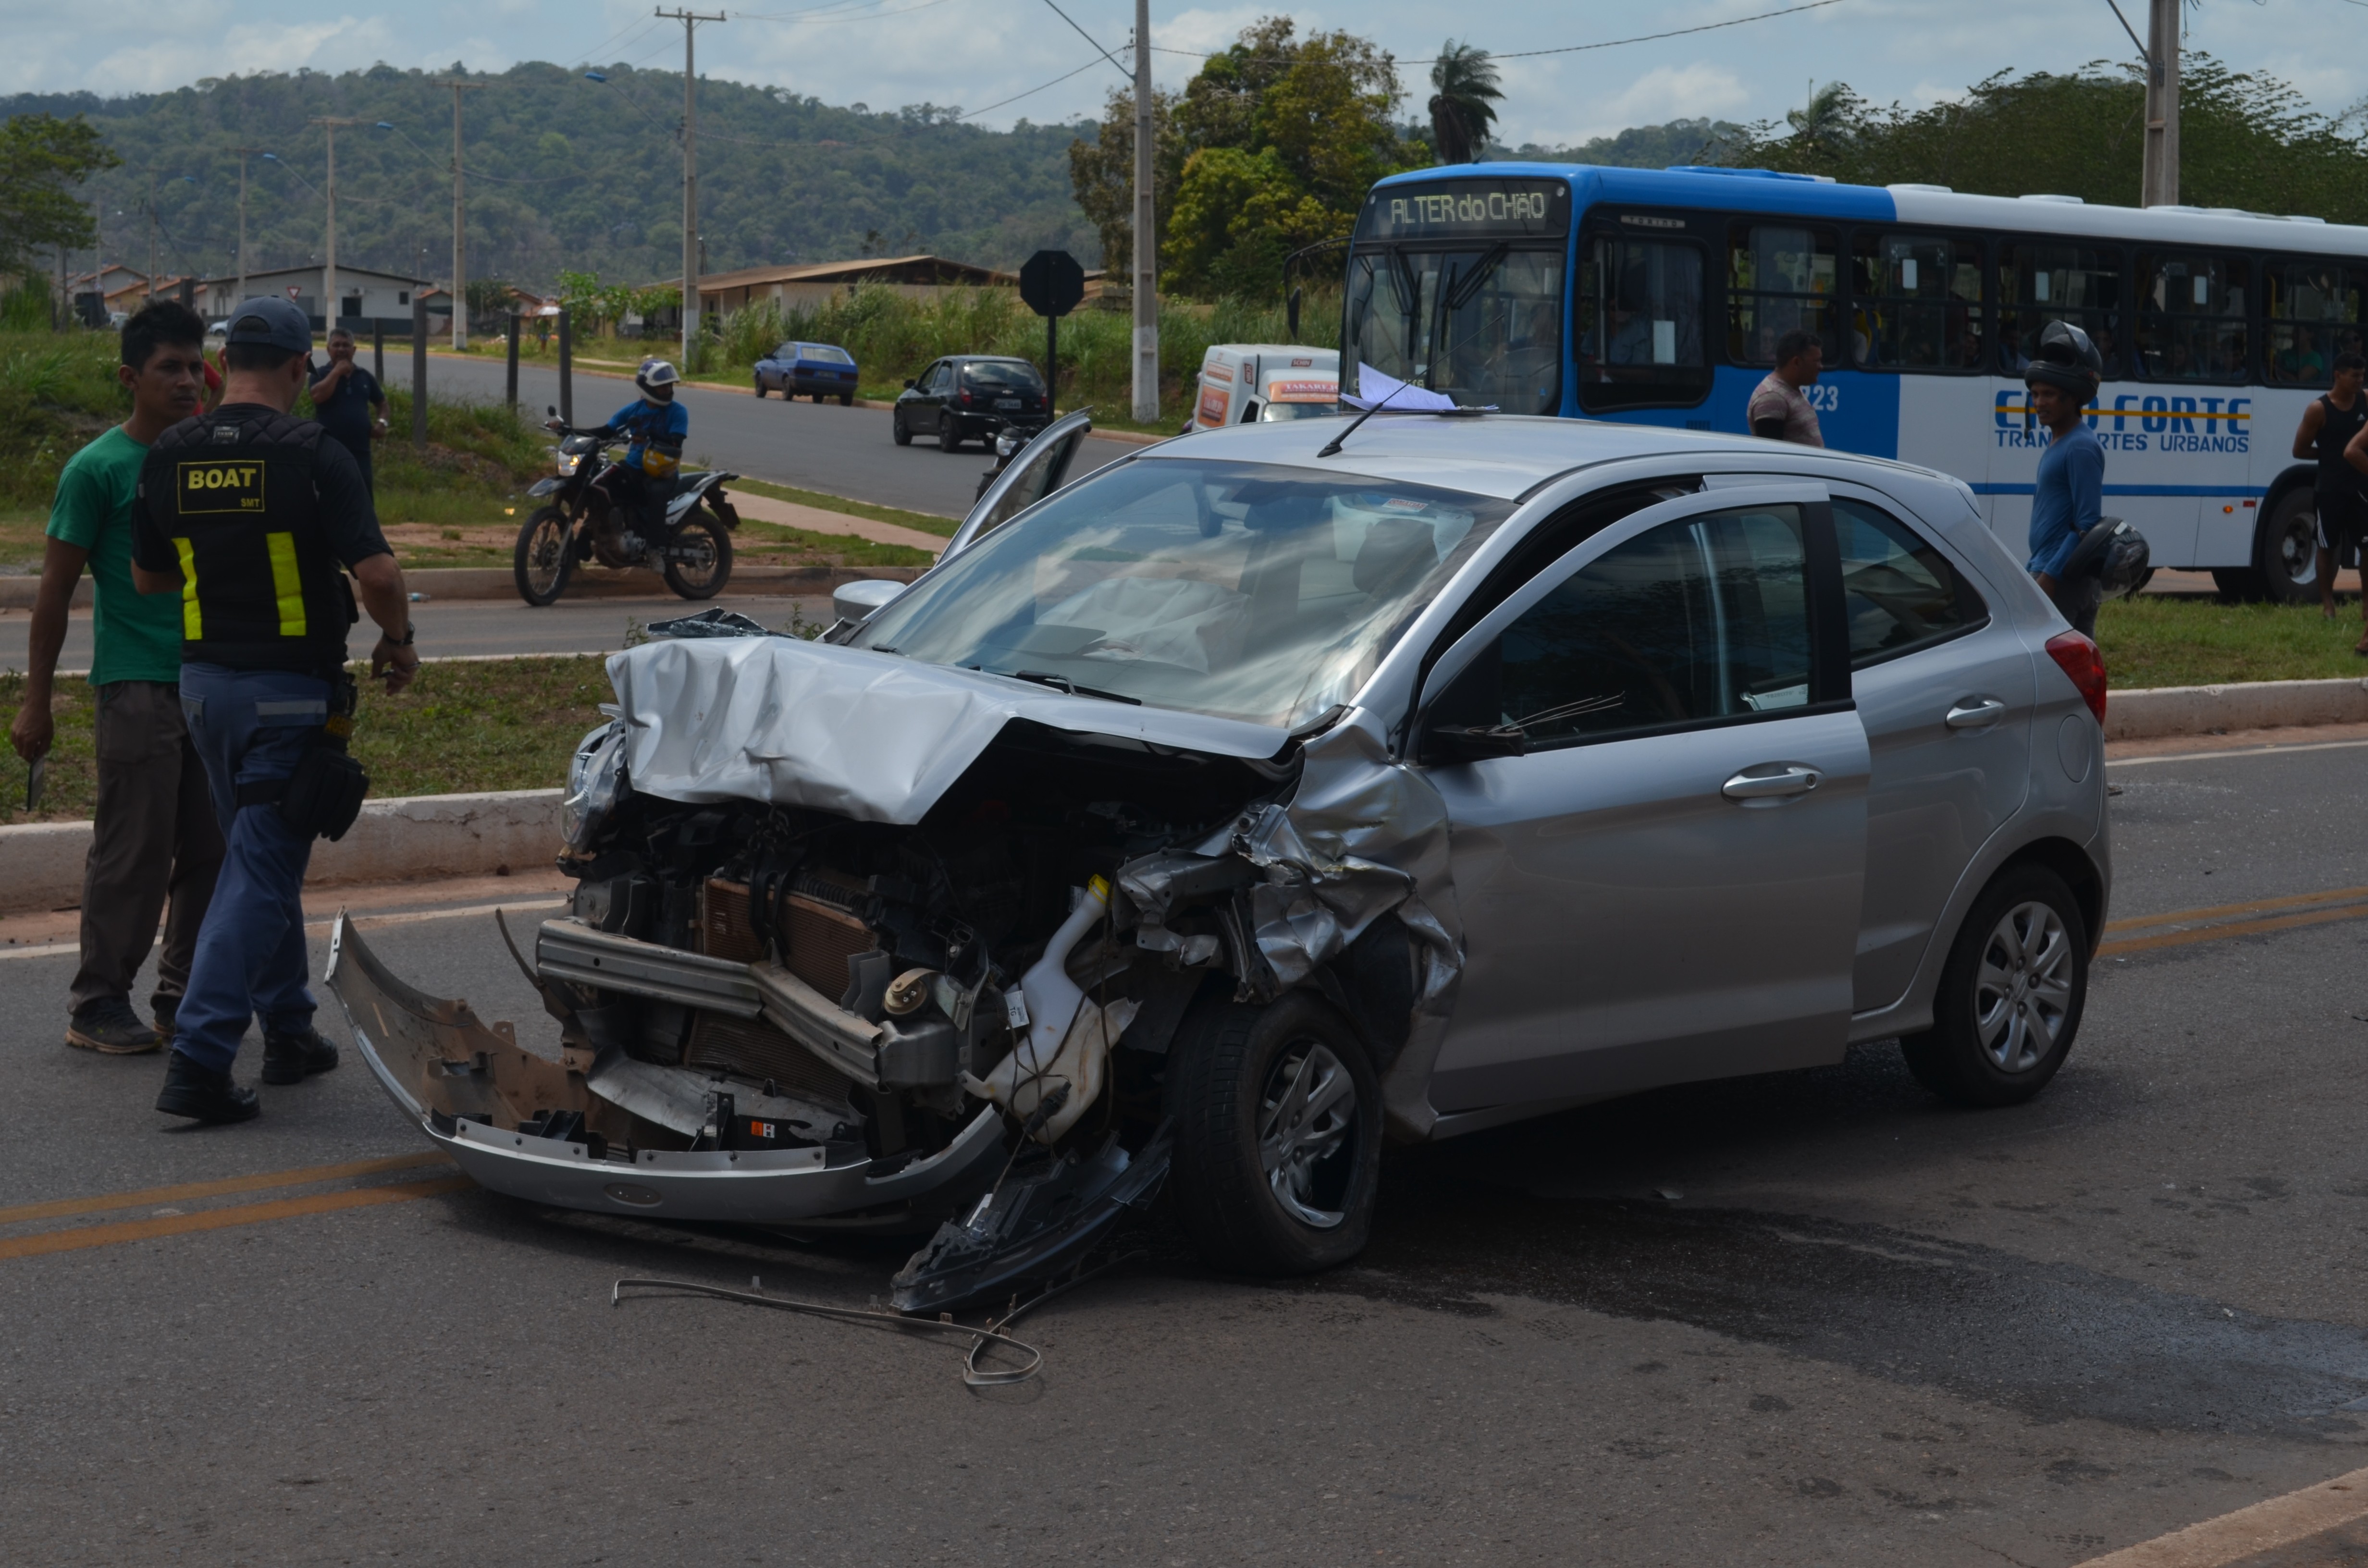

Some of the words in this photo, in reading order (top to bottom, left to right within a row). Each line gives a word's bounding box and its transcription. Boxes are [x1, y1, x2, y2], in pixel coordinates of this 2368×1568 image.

[1391, 195, 1455, 224] ALTER
[1458, 194, 1486, 221] do
[1994, 429, 2148, 451] TRANRTES
[2160, 434, 2249, 453] URBANOS
[187, 468, 257, 490] BOAT
[240, 498, 260, 507] SMT
[1010, 1007, 1016, 1016] TG
